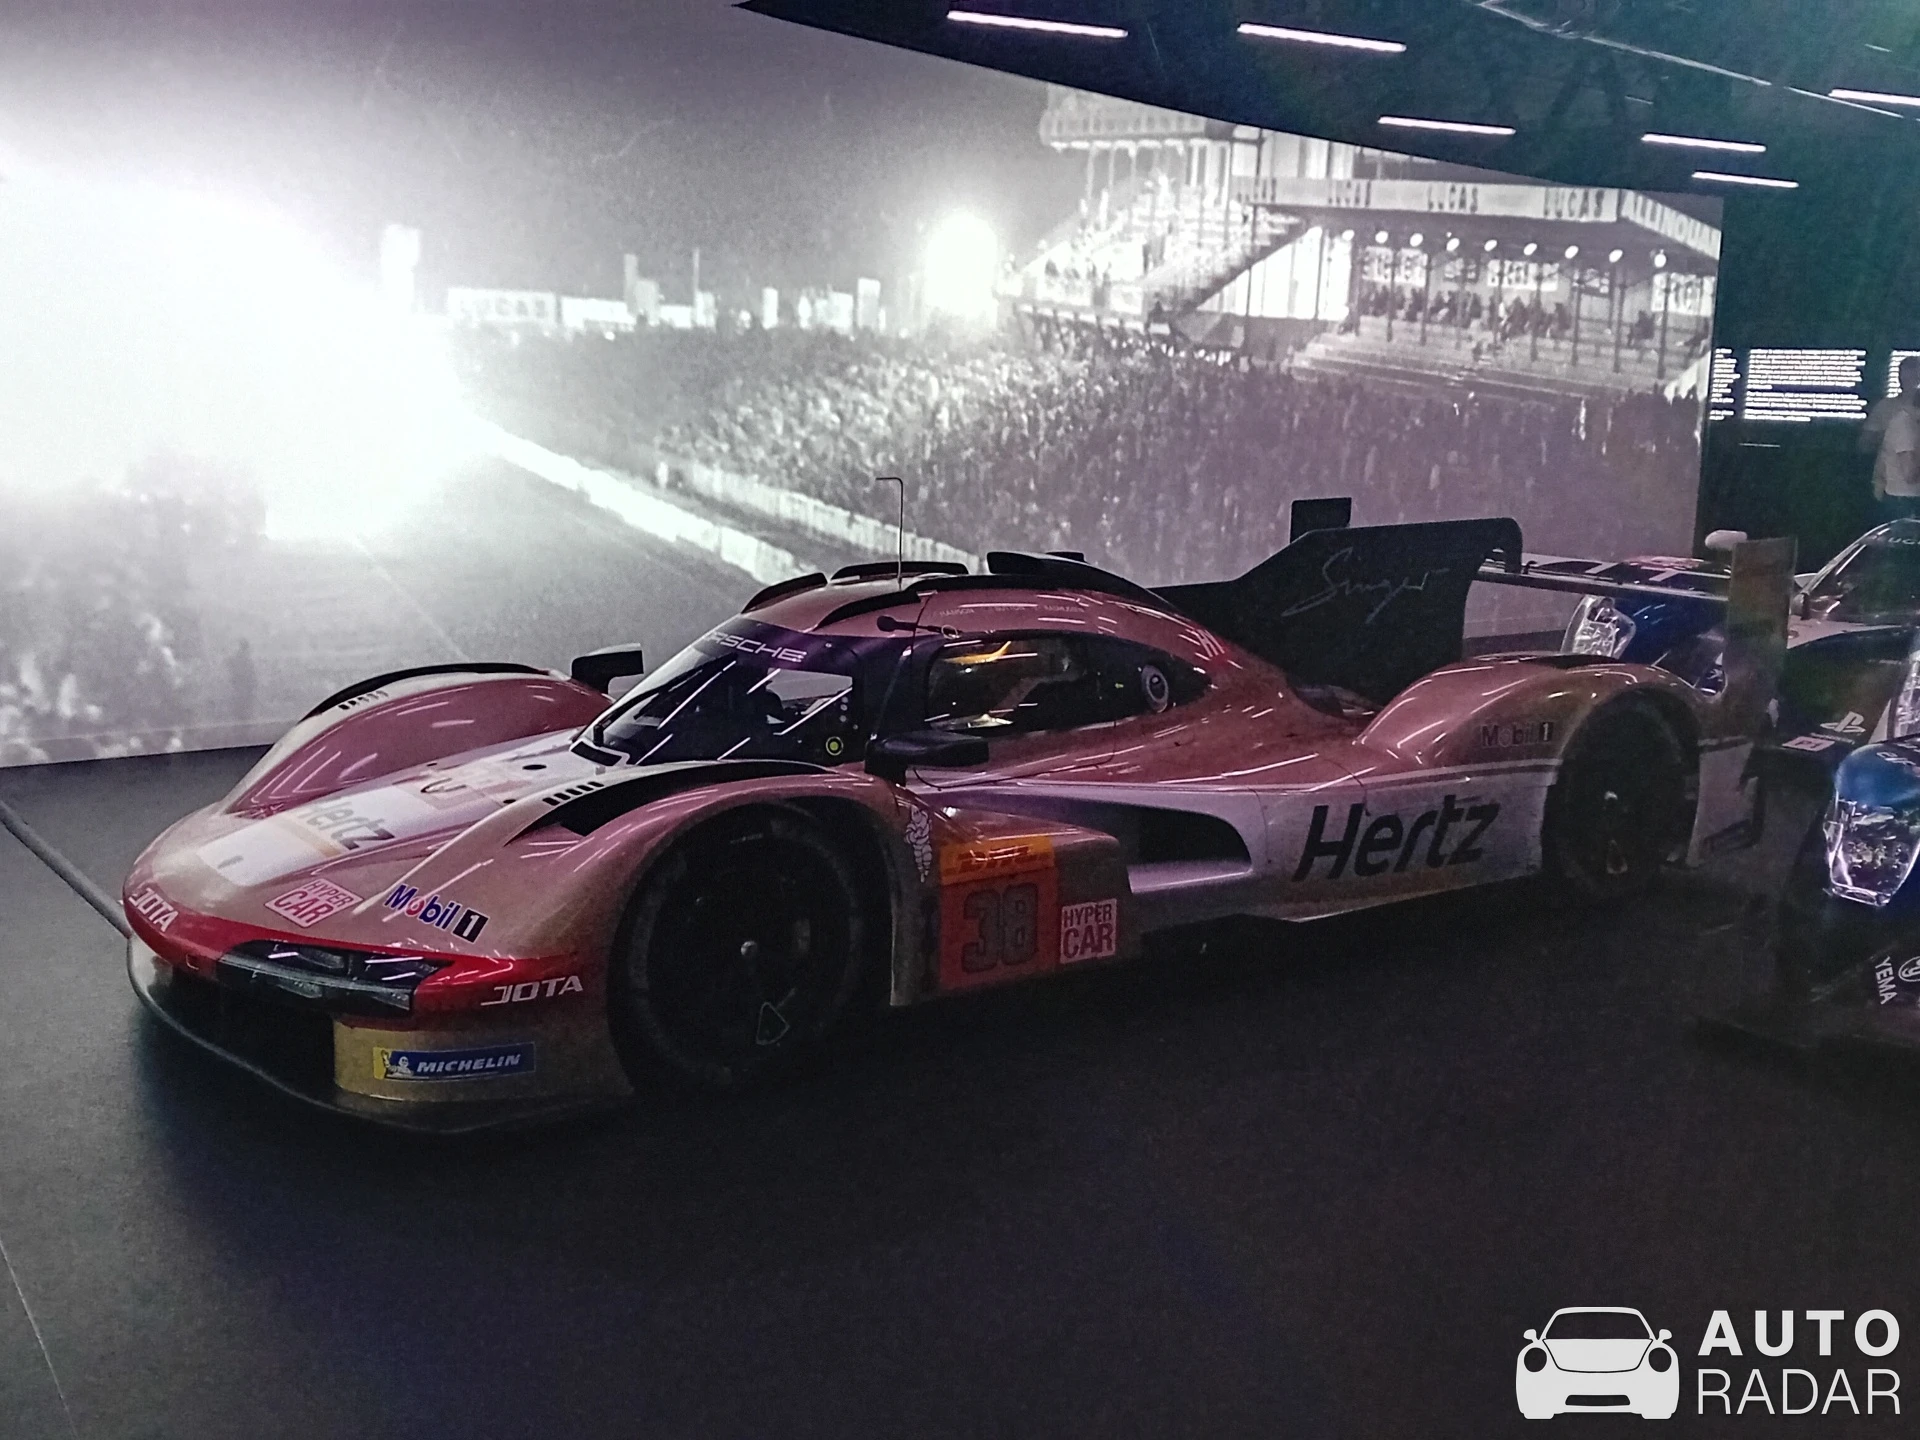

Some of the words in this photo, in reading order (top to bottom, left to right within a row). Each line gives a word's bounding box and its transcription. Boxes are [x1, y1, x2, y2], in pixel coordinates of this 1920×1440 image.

[708, 631, 807, 663] RSCHE
[1292, 794, 1500, 882] Hertz
[128, 887, 179, 933] JOTA
[273, 890, 335, 923] CAR
[307, 879, 354, 908] HYPER
[384, 884, 461, 930] Mobil
[961, 882, 1040, 974] 38
[1063, 903, 1113, 928] HYPER
[1063, 923, 1114, 959] CAR
[480, 975, 584, 1006] JOTA
[1875, 955, 1898, 1005] YEMA
[416, 1053, 522, 1074] MICHELIN
